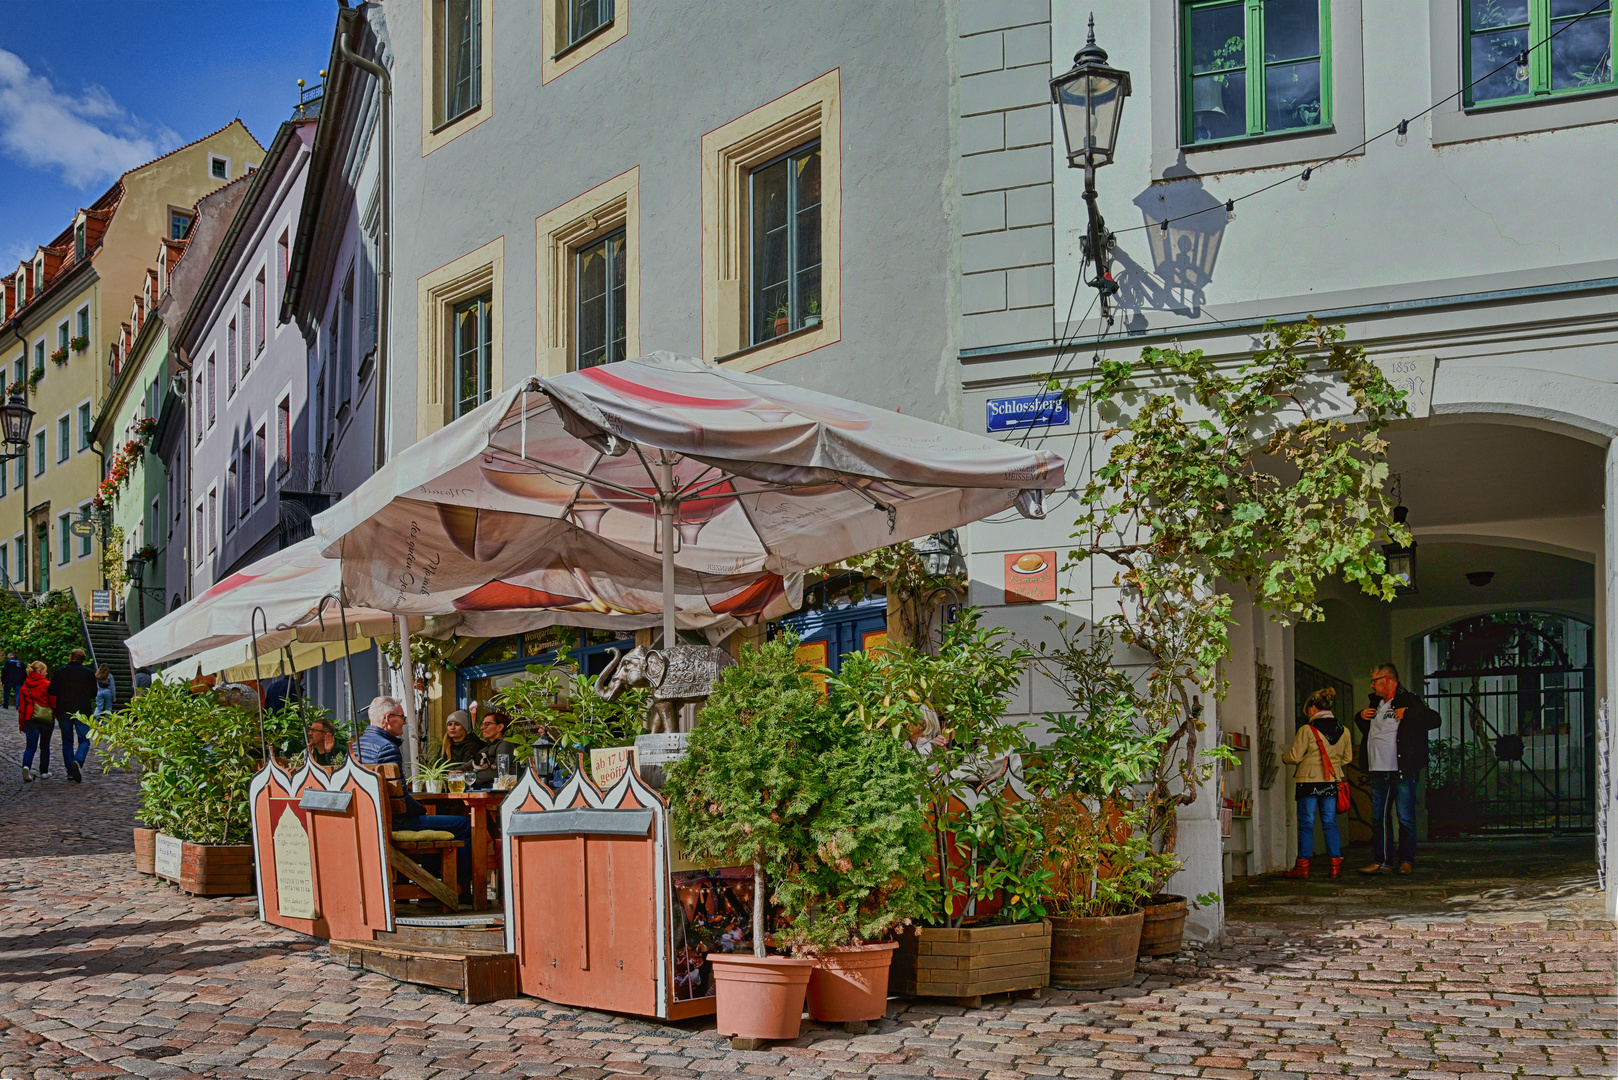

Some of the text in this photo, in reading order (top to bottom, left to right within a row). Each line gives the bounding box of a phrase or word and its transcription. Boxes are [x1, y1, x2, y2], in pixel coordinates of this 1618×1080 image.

[1391, 359, 1417, 374] 1856
[991, 398, 1063, 416] Schlossberg
[1003, 463, 1036, 472] WINZER
[1003, 472, 1036, 482] MEISSEN
[404, 535, 417, 570] guten
[1009, 571, 1051, 585] Fummel
[1014, 586, 1044, 598] Platz
[595, 757, 606, 771] ab
[607, 753, 616, 766] 17
